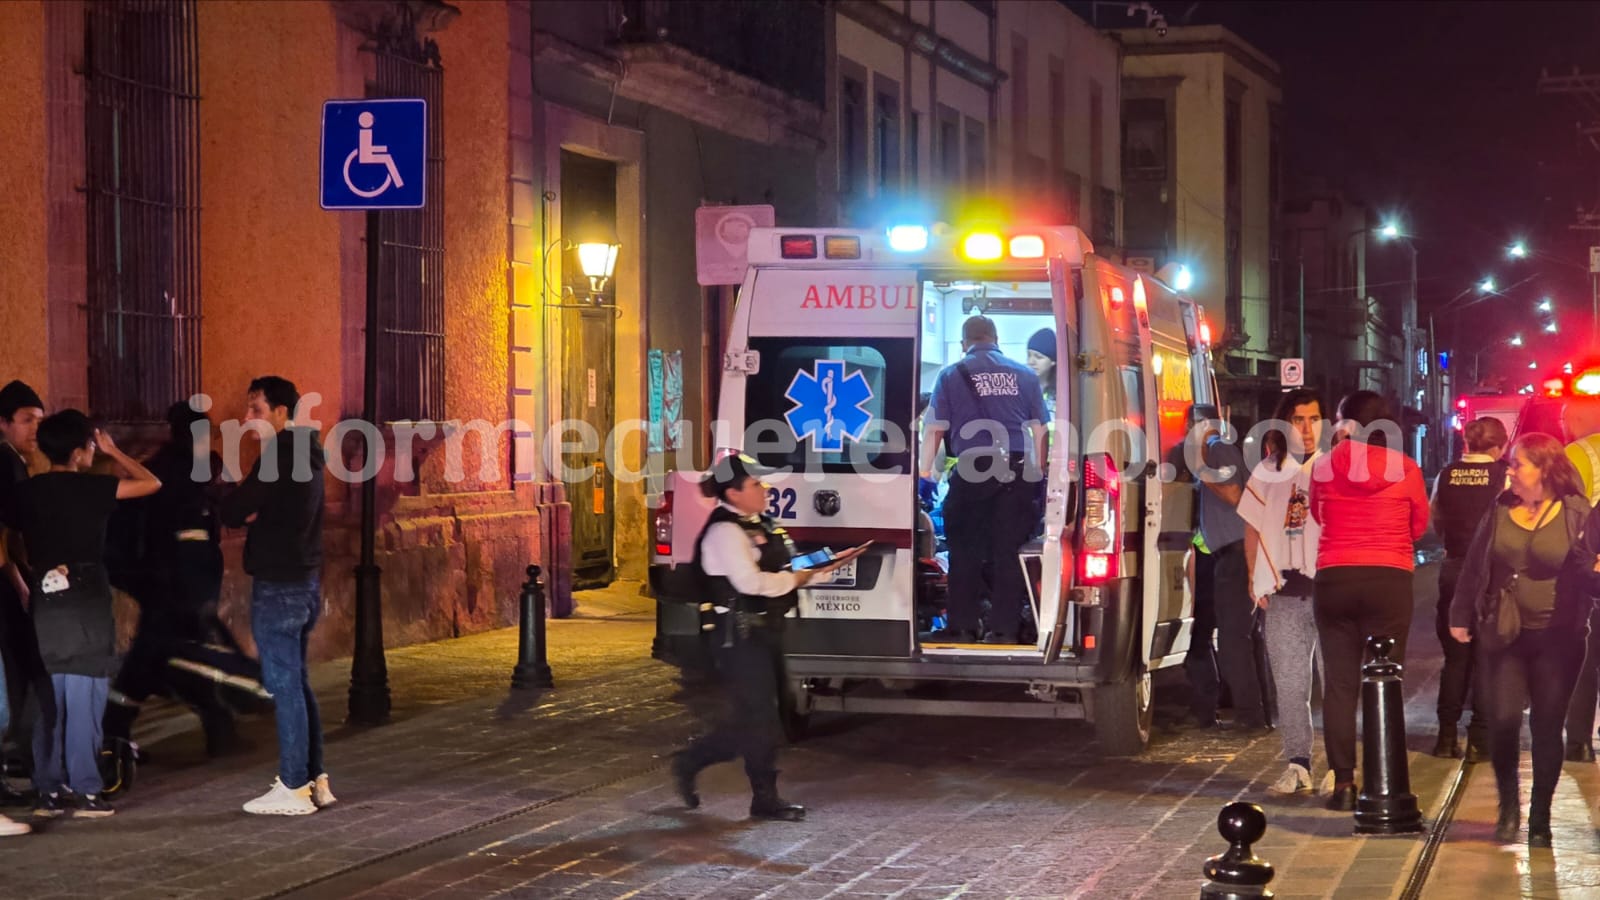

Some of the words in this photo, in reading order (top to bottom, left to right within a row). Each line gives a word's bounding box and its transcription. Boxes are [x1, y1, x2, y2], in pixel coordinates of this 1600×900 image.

[1451, 468, 1489, 477] GUARDIA
[1449, 477, 1489, 485] AUXILIAR
[815, 601, 861, 611] MÉXICO
